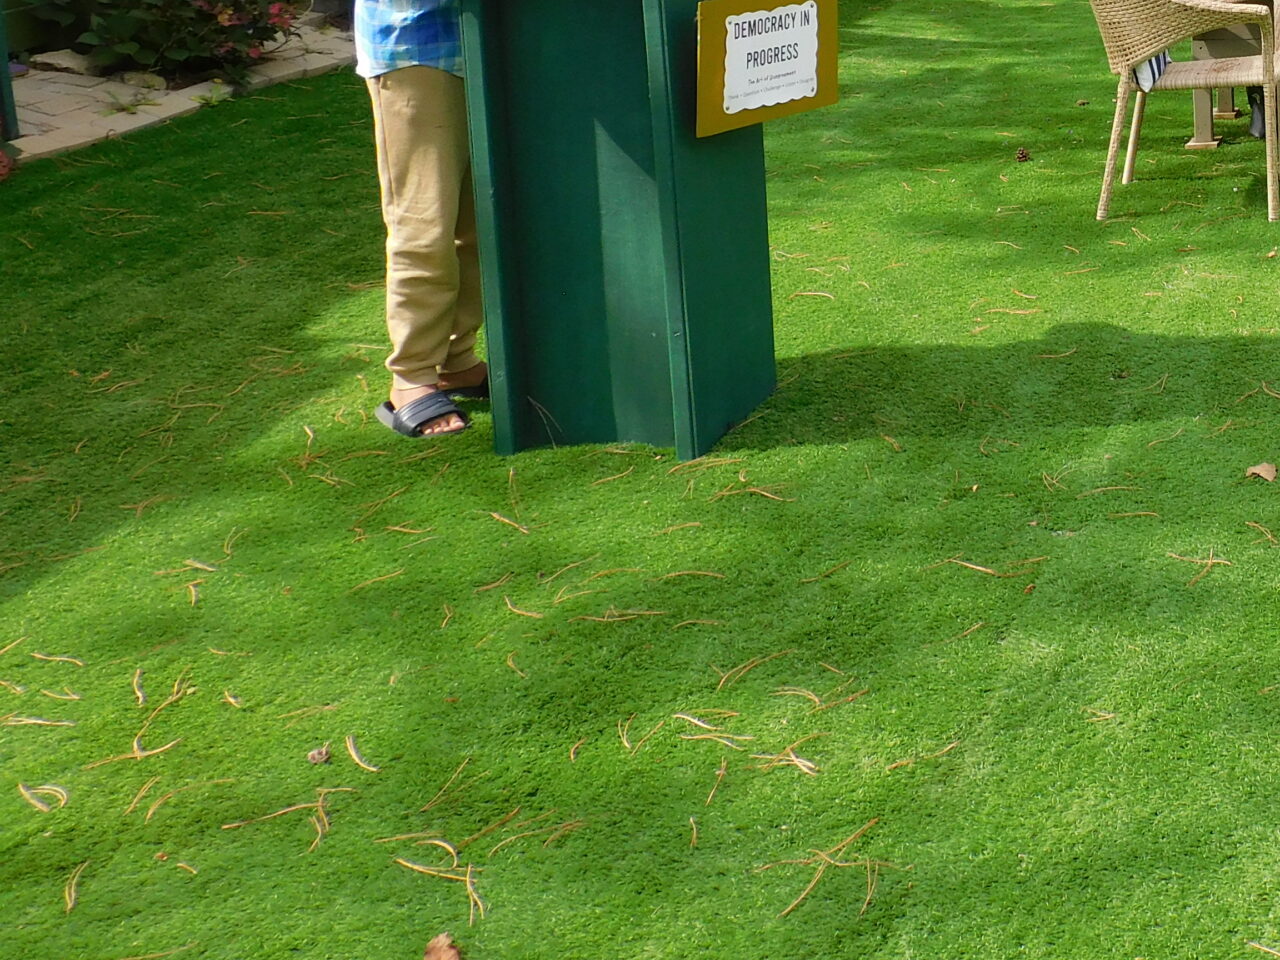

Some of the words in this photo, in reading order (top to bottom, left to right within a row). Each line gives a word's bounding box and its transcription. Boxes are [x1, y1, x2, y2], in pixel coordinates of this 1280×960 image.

[734, 11, 797, 40] DEMOCRACY
[800, 9, 810, 27] IN
[746, 42, 799, 70] PROGRESS
